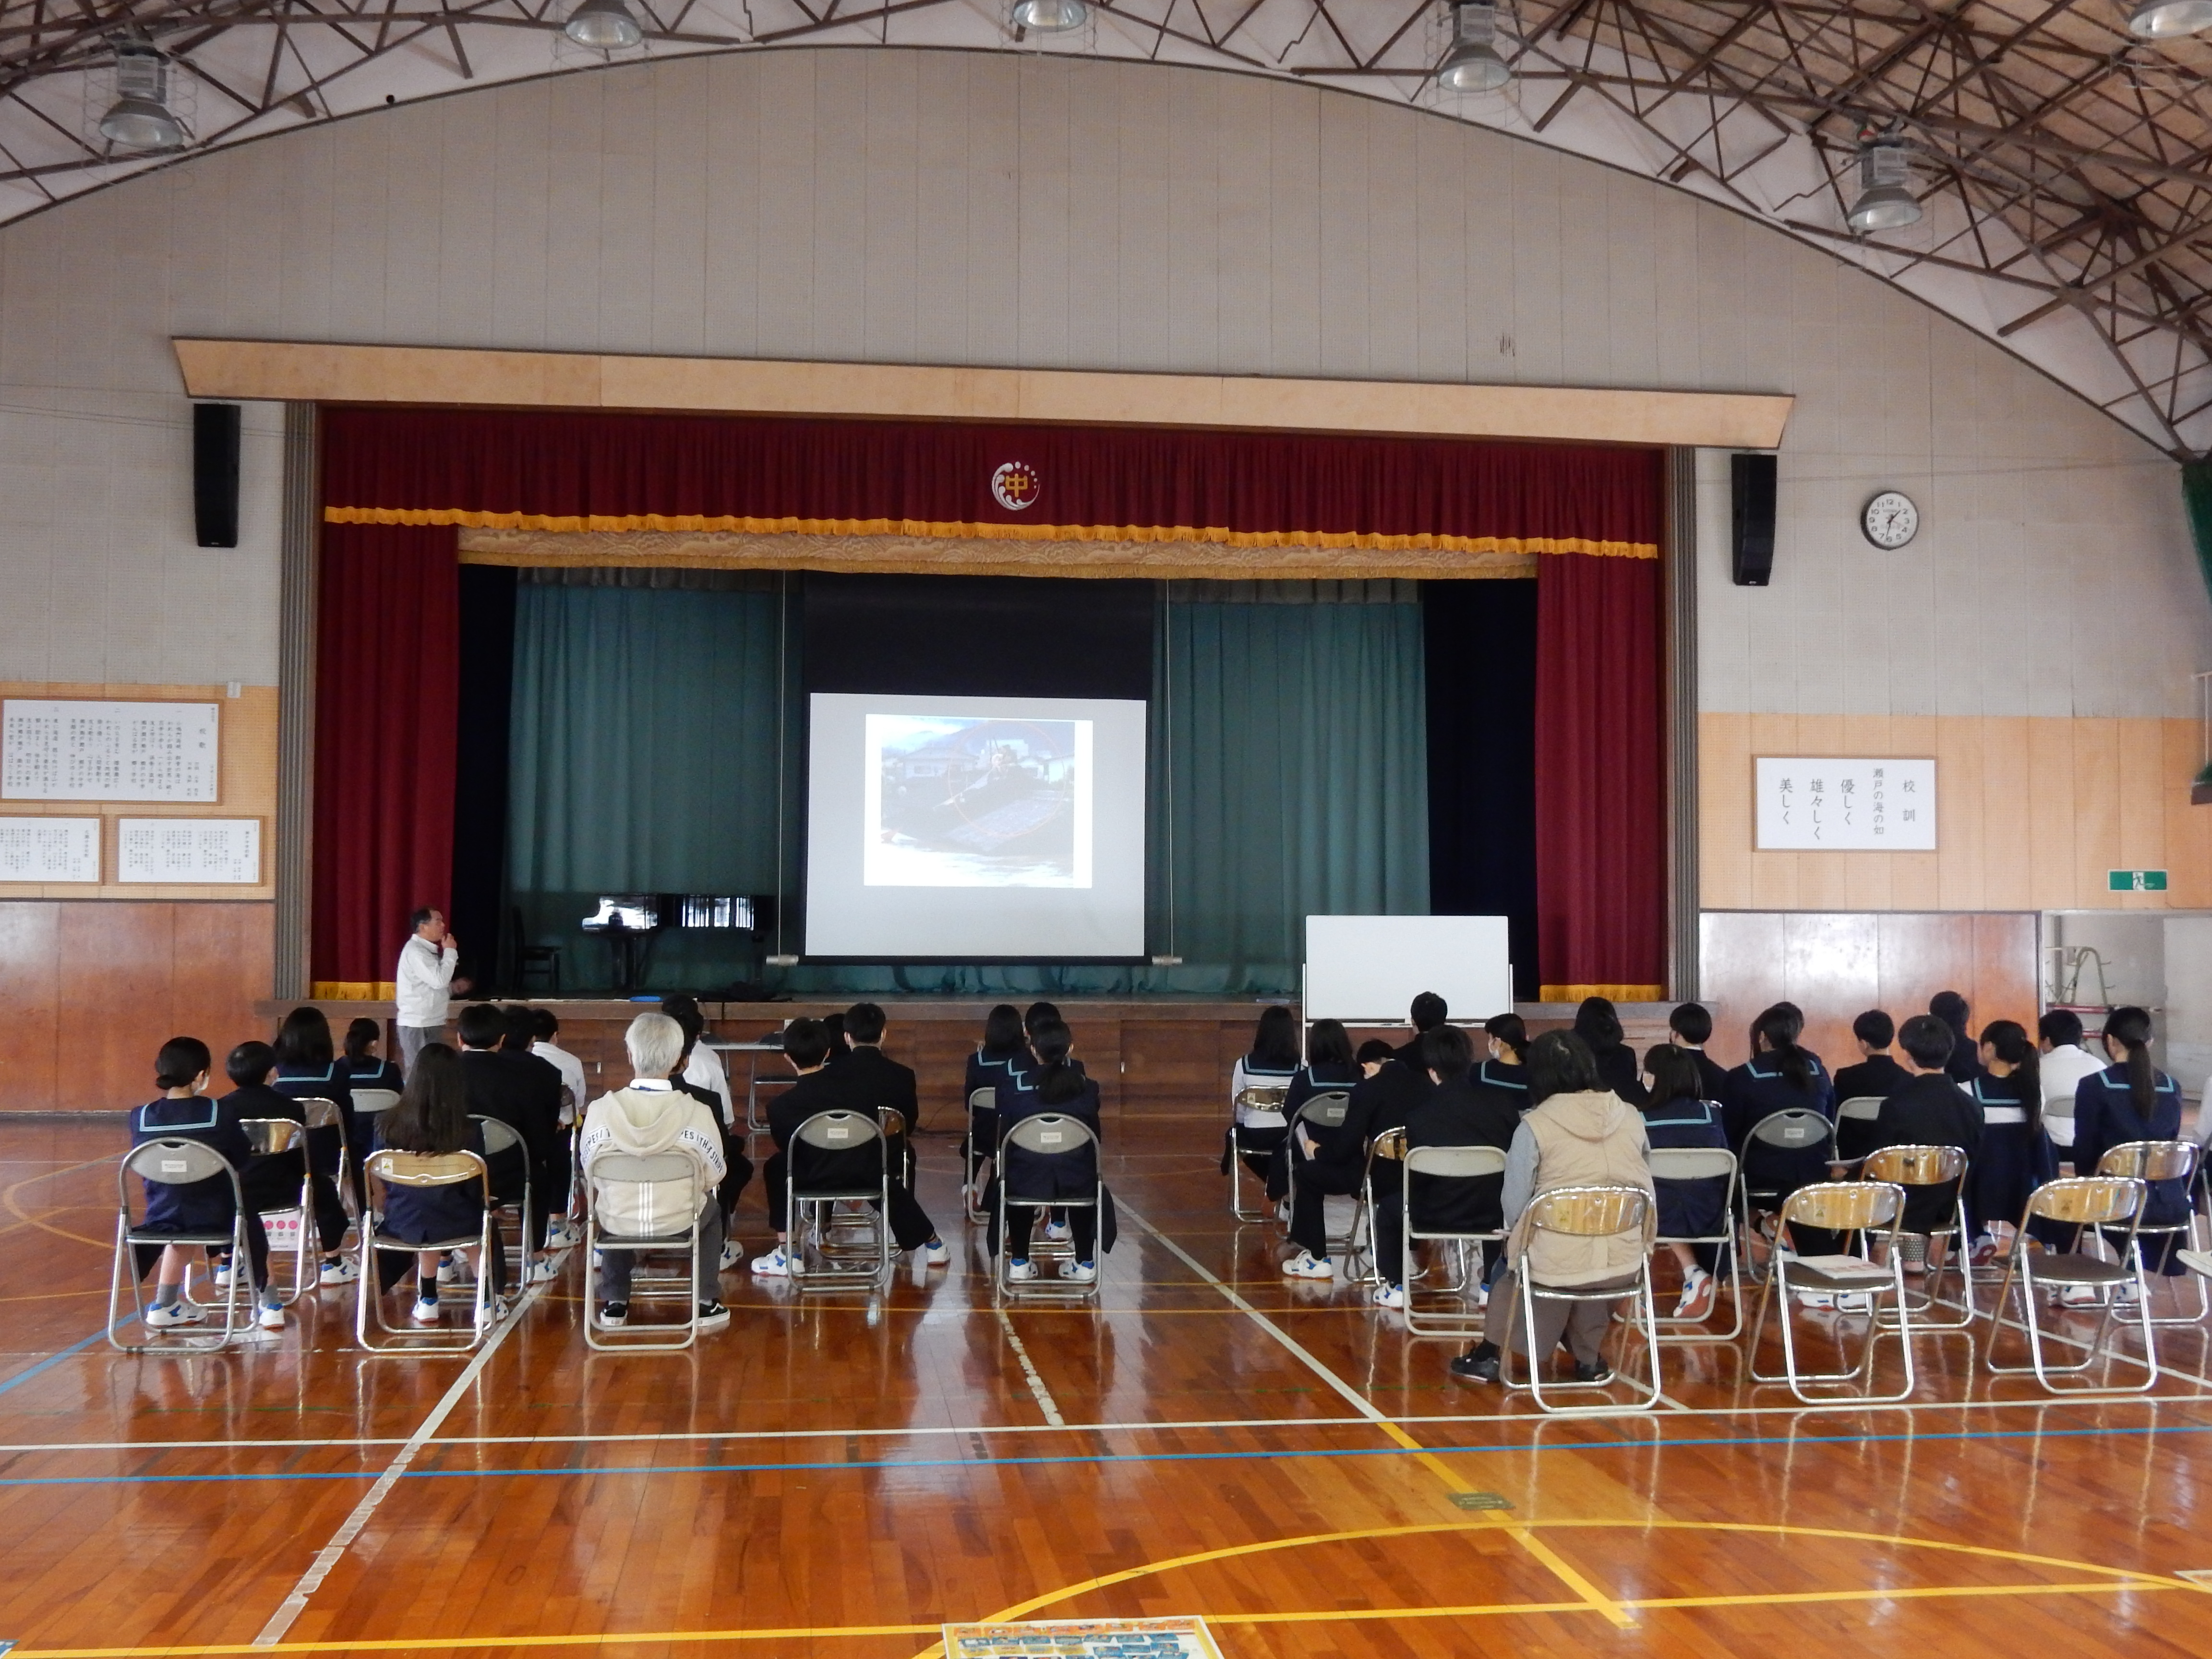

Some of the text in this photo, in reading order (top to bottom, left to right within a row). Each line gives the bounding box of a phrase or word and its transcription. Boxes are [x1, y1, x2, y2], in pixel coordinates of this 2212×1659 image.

[1779, 778, 1793, 825] 美しく
[1810, 779, 1824, 840] 雄々しく
[1840, 778, 1855, 825] 優しく
[1873, 768, 1884, 835] 瀬戸の海の如
[1902, 780, 1916, 822] 校訓
